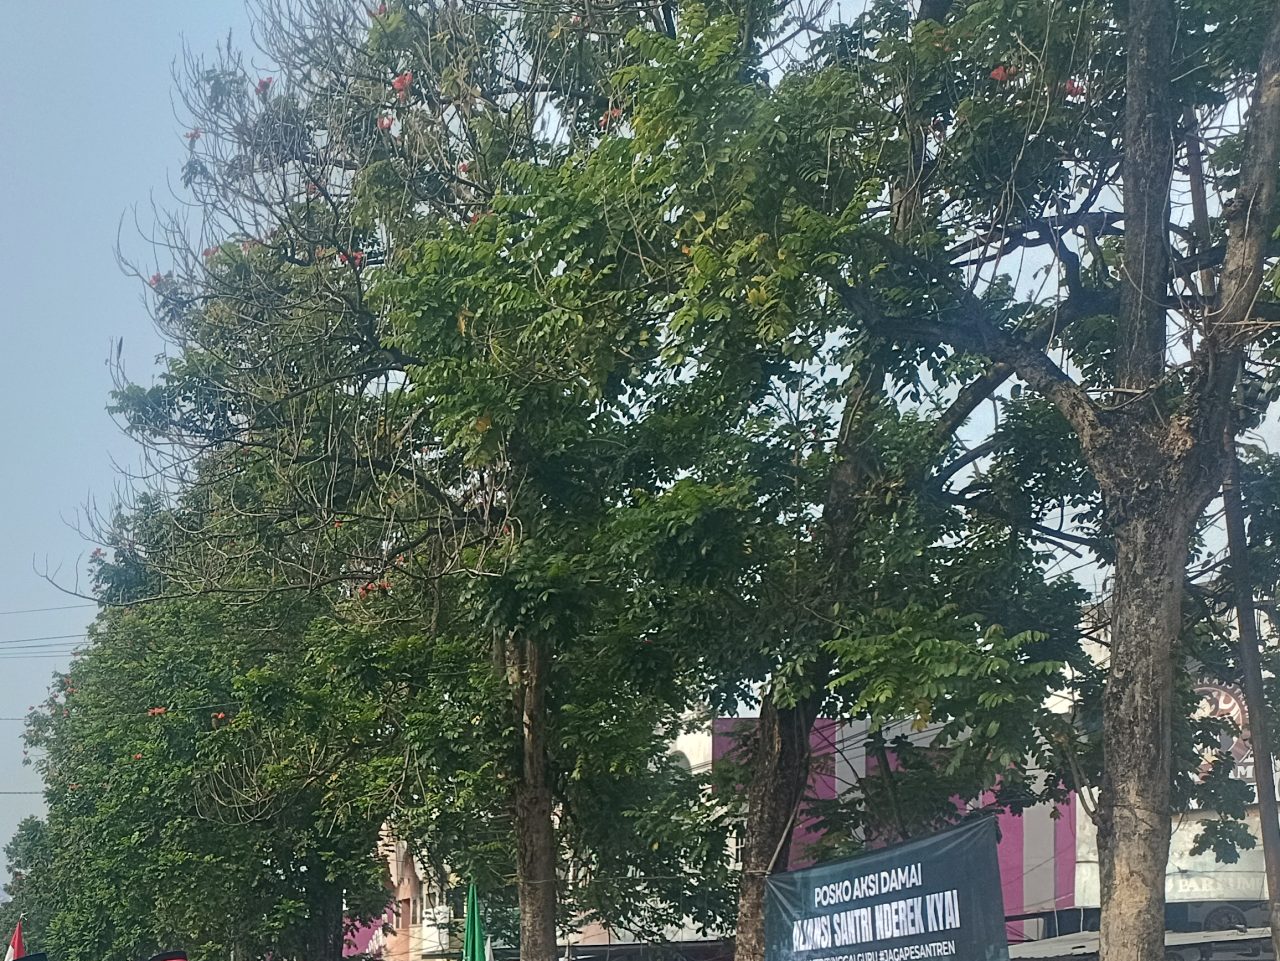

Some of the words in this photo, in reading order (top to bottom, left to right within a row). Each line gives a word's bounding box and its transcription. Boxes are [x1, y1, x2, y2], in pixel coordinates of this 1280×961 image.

[815, 880, 851, 908] POSKO
[853, 872, 879, 899] AKSI
[880, 863, 923, 893] DAMAI
[793, 915, 832, 952] ALIANSI
[833, 907, 873, 946] SANTRI
[875, 897, 925, 940] NDEREK
[926, 890, 961, 932] KYAI
